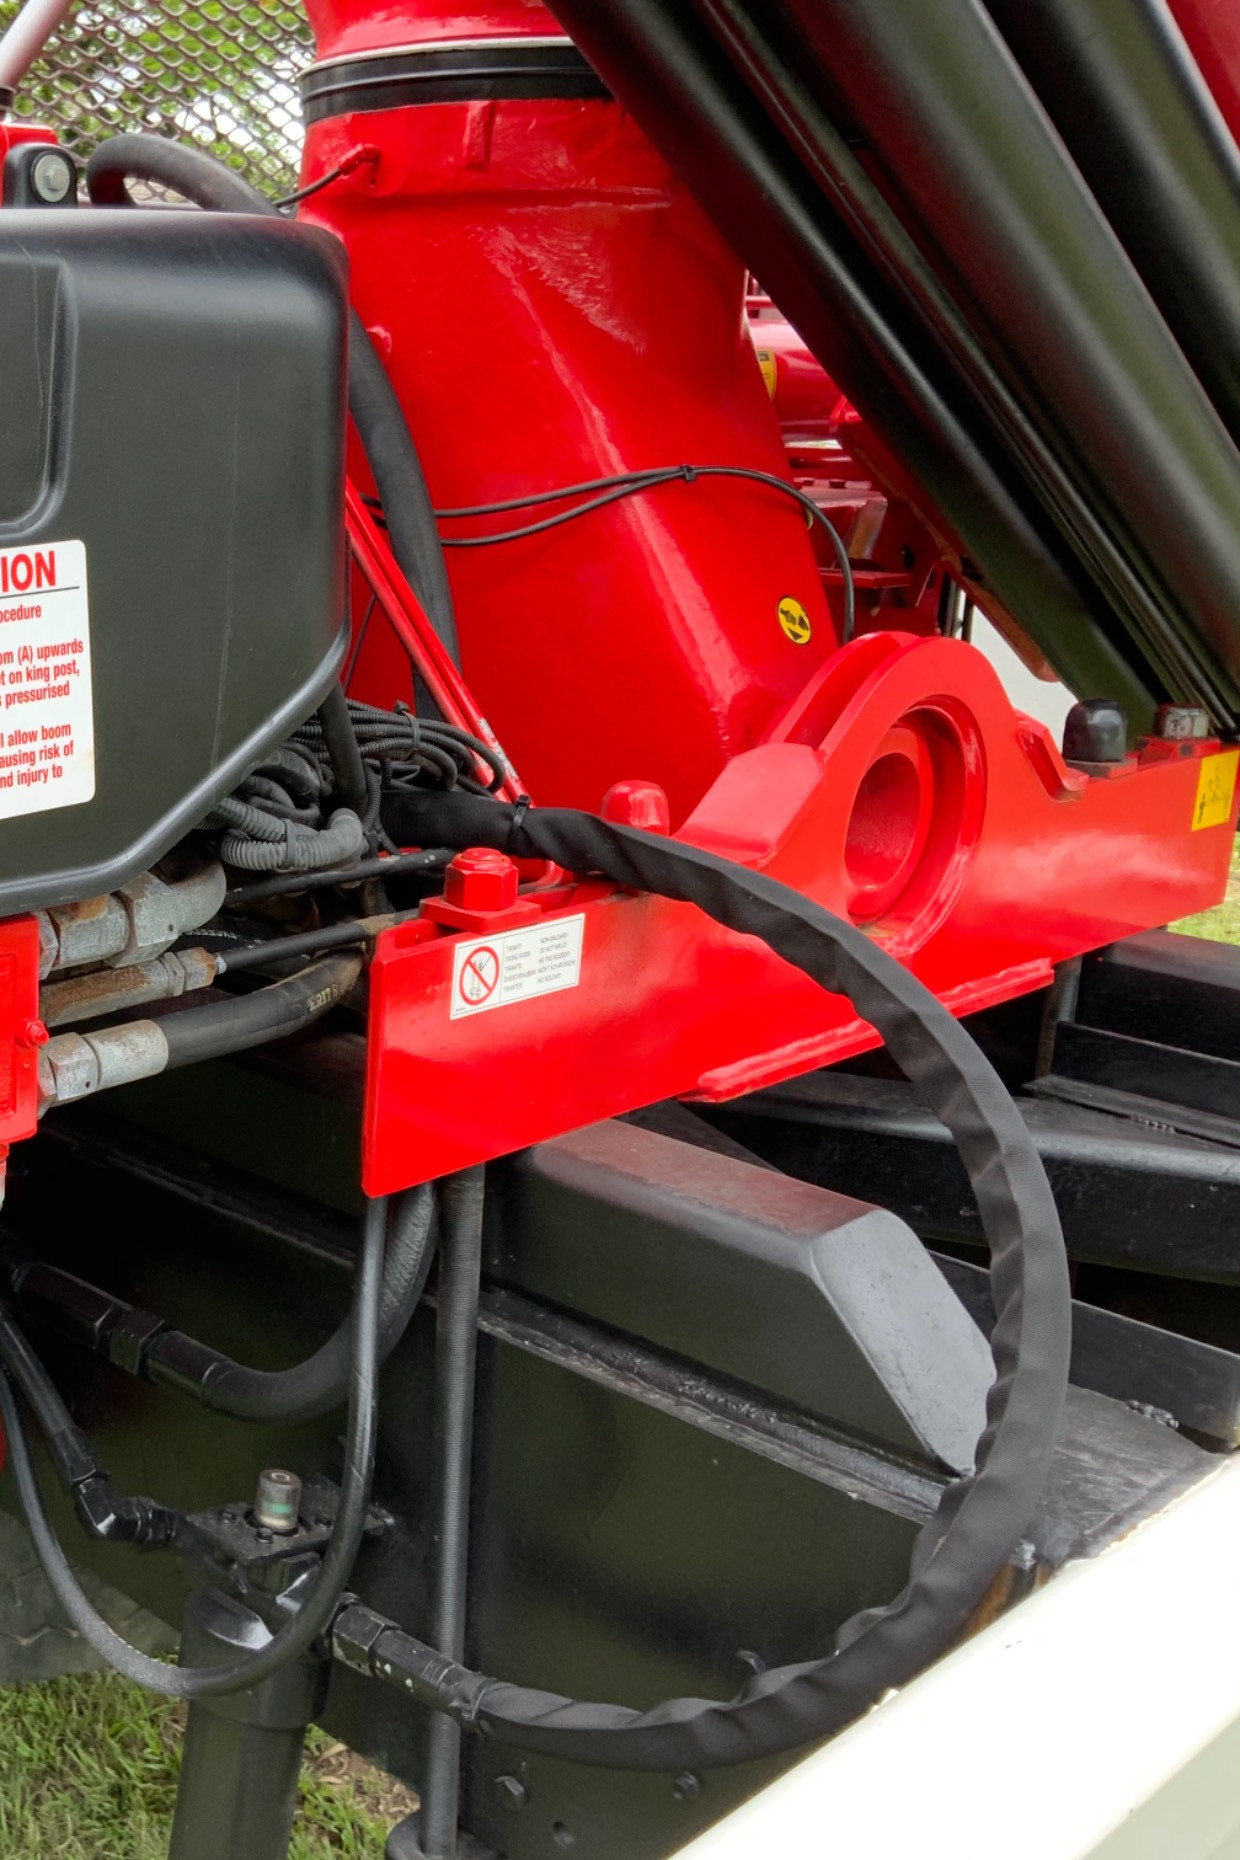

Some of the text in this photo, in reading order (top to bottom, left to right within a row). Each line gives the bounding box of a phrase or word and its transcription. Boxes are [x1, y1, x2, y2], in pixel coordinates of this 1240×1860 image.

[17, 645, 35, 664] (A)
[37, 640, 85, 661] upwards
[8, 670, 24, 684] on
[25, 666, 51, 682] king
[53, 660, 81, 680] post,
[5, 681, 71, 708] pressurised
[7, 730, 39, 747] allow
[41, 724, 72, 741] boom
[39, 744, 61, 760] risk
[63, 740, 75, 756] of
[17, 768, 50, 786] injury
[51, 764, 64, 778] to
